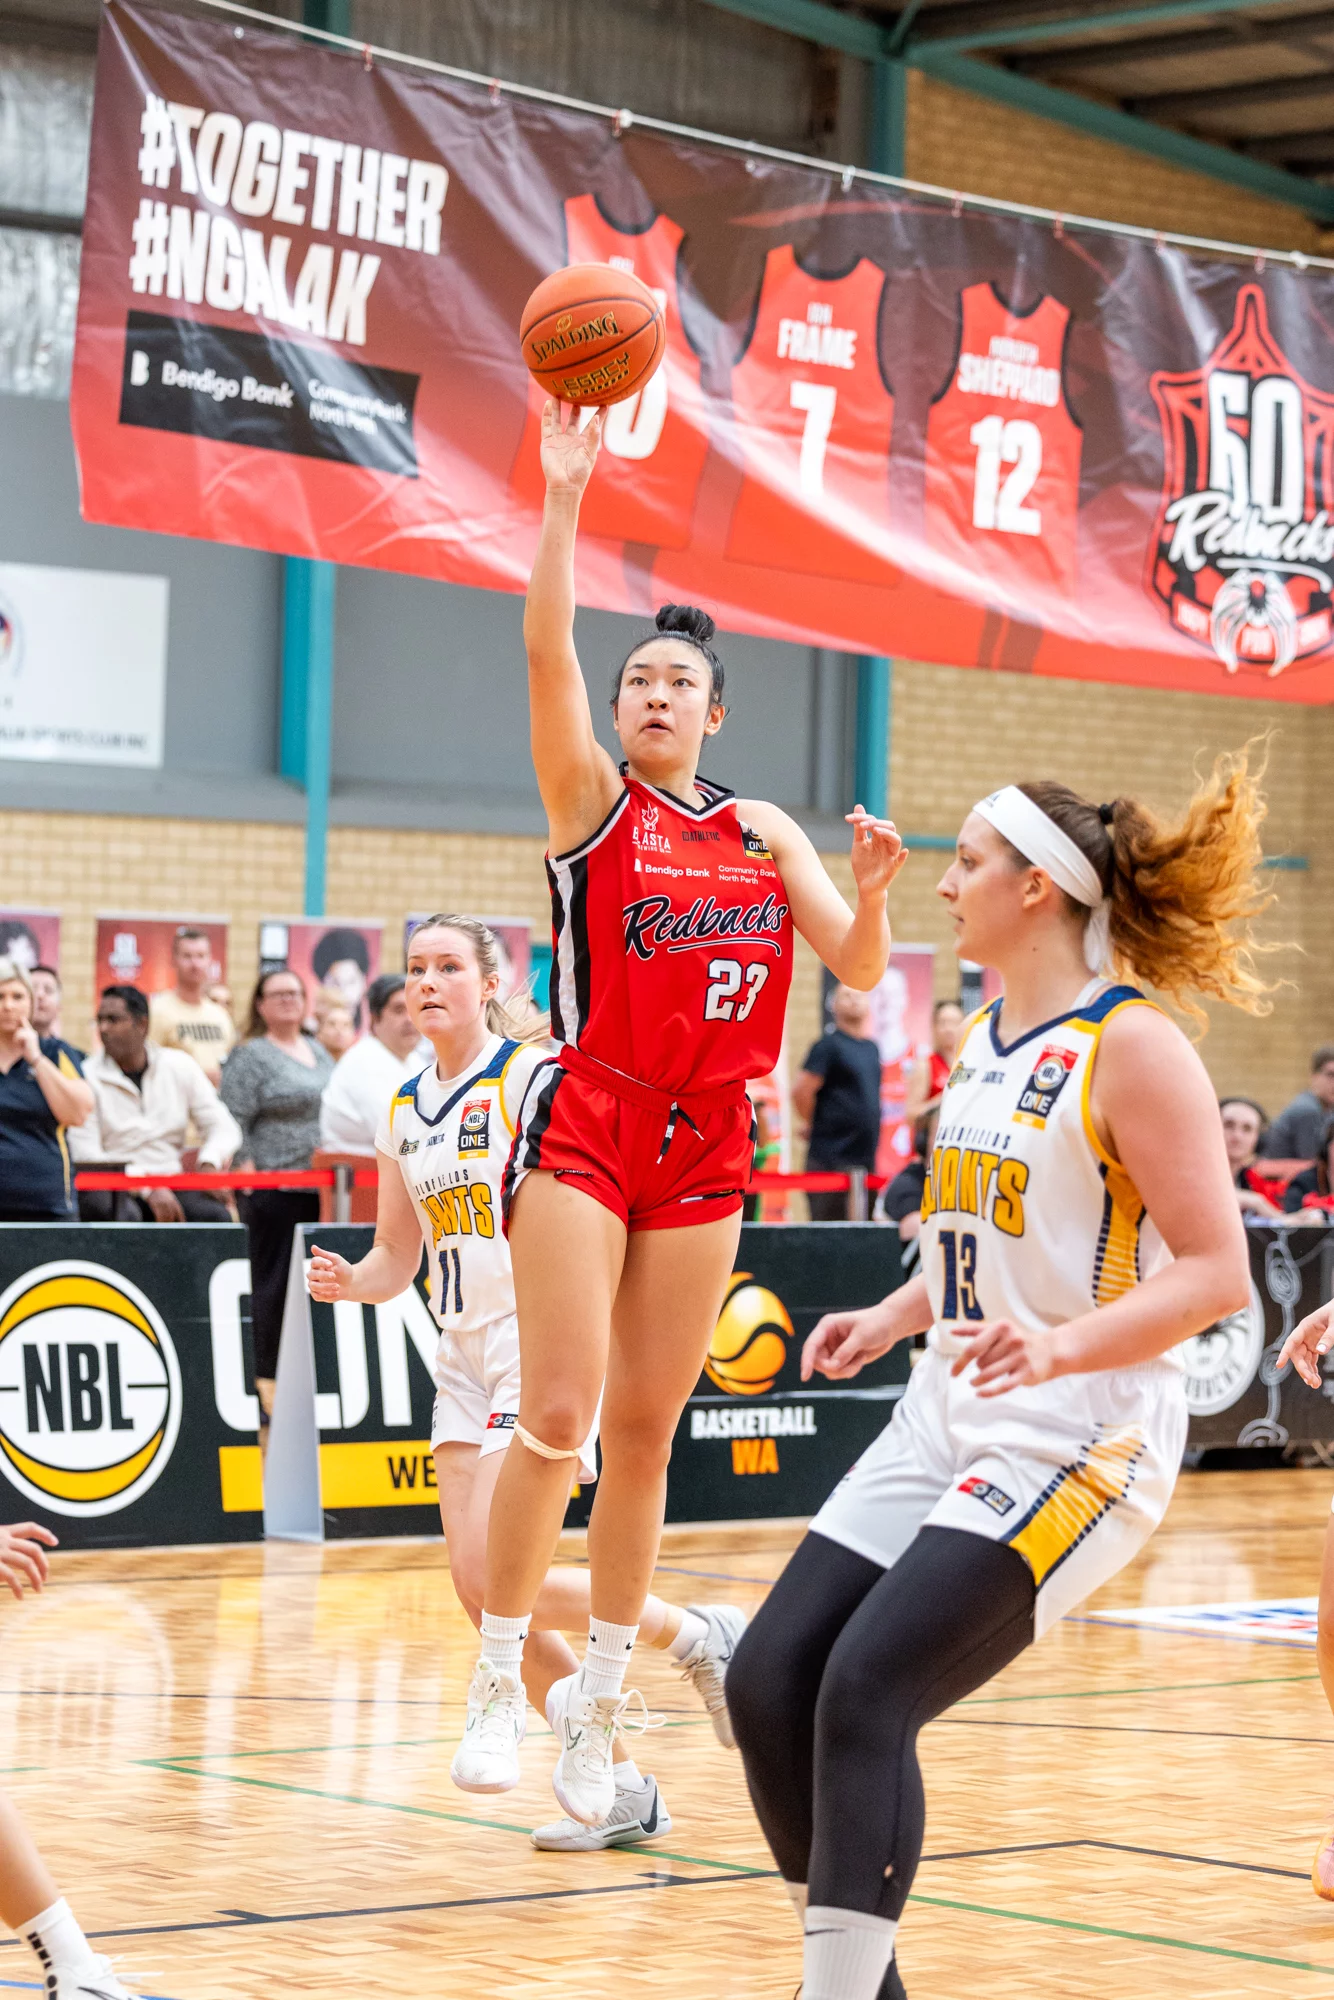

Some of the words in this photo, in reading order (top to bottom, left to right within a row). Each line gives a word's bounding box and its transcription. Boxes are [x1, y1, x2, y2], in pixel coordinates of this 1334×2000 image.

[138, 93, 449, 256] #TOGETHER
[129, 198, 381, 347] #NGALAK
[531, 311, 619, 364] SPALDING
[777, 317, 857, 370] FRAME
[161, 360, 240, 403] Bendigo
[241, 376, 295, 409] Bank
[551, 351, 630, 392] LEGACY
[789, 380, 837, 499] 7
[1208, 371, 1305, 526] 60
[969, 414, 1043, 536] 12
[1164, 490, 1334, 573] Redbacks
[632, 825, 671, 850] BASTA
[645, 864, 684, 878] Bendigo
[686, 868, 711, 878] Bank
[718, 865, 758, 877] Community
[759, 869, 777, 878] Bank
[718, 874, 739, 883] North
[740, 876, 759, 885] Perth
[623, 893, 788, 961] Redbacks
[702, 957, 770, 1023] 23
[468, 1114, 481, 1124] NBL
[1020, 1090, 1053, 1114] ONE
[460, 1134, 486, 1148] ONE
[438, 1248, 464, 1316] 11
[938, 1229, 984, 1321] 13
[22, 1342, 135, 1433] NBL
[690, 1406, 817, 1440] BASKETBALL
[387, 1455, 438, 1490] WE
[731, 1437, 780, 1476] WA
